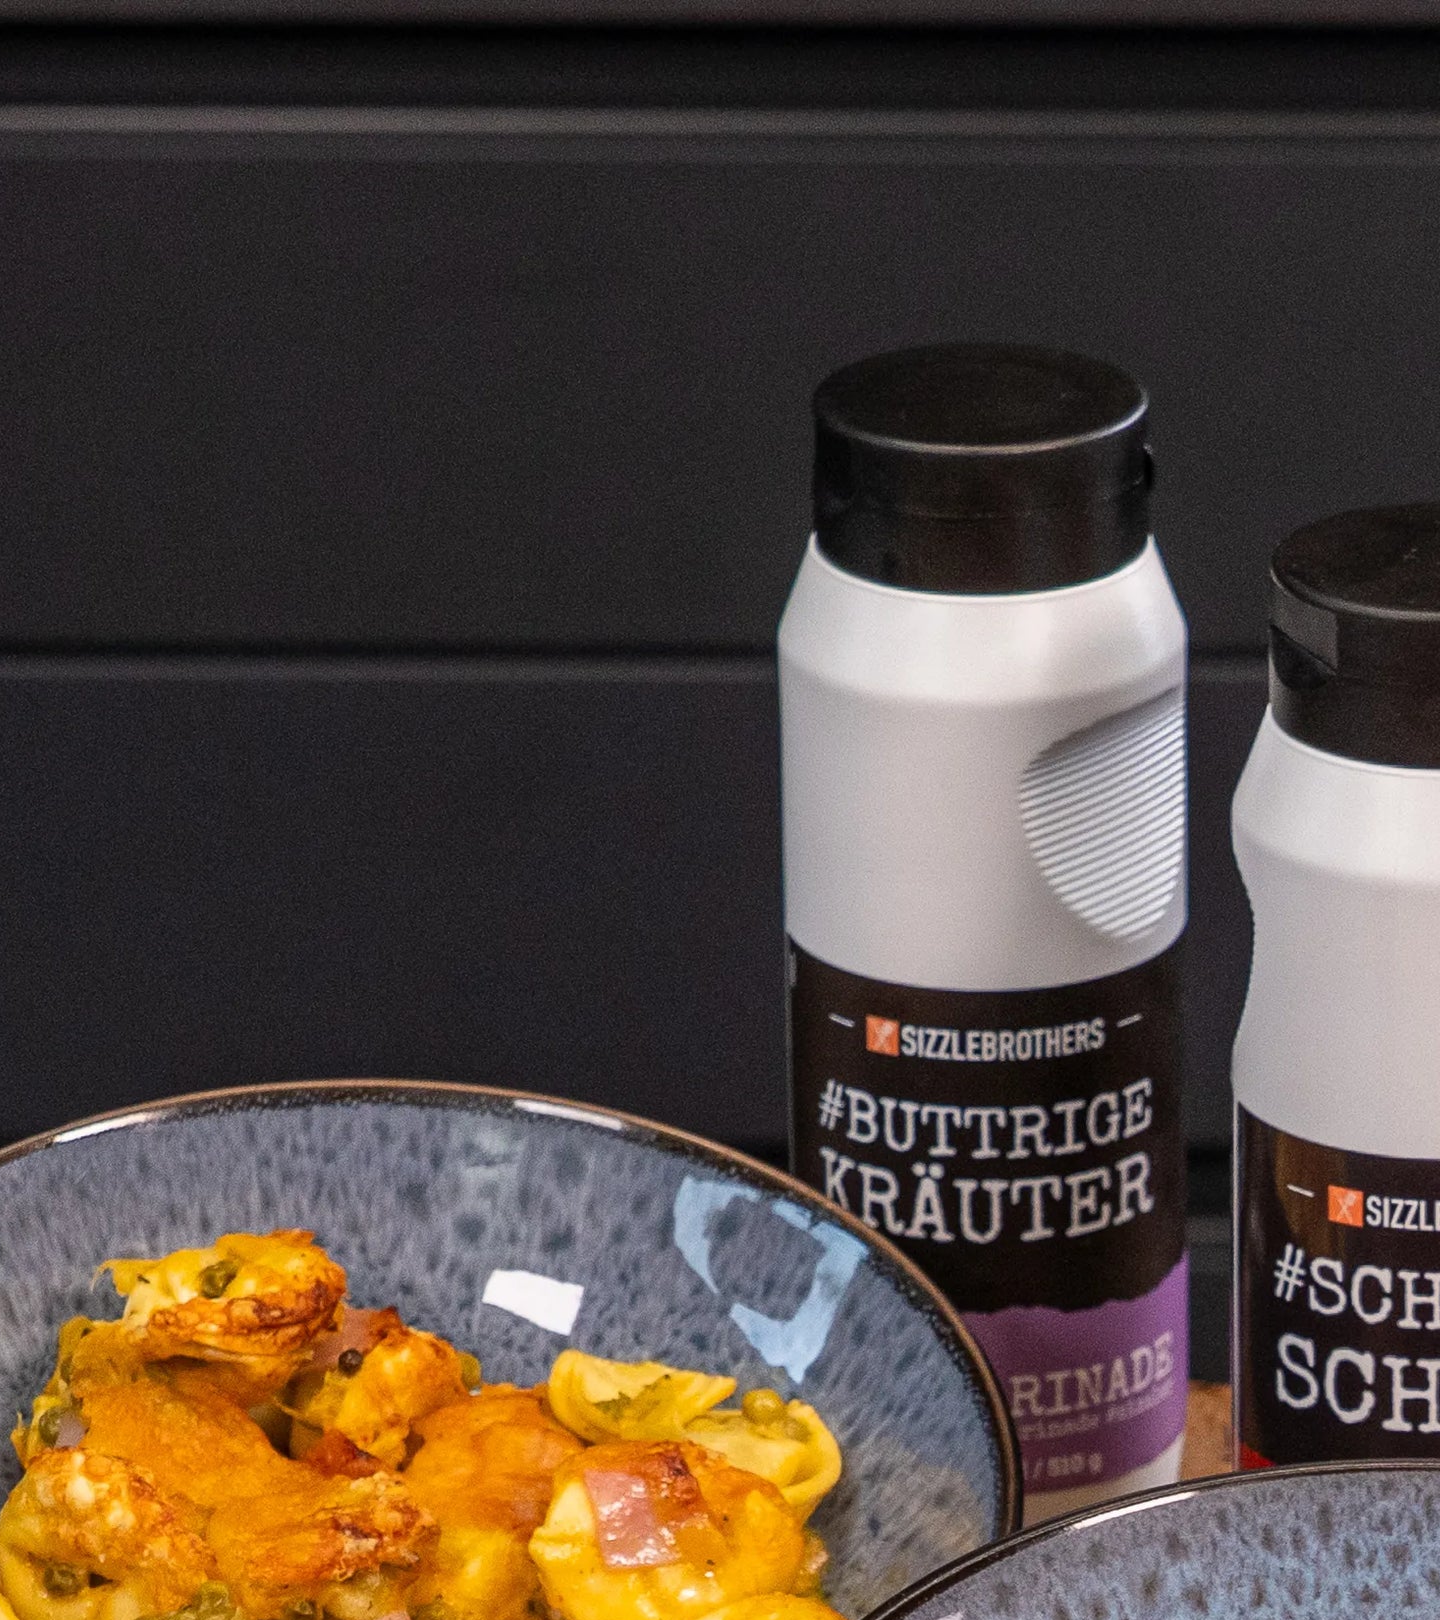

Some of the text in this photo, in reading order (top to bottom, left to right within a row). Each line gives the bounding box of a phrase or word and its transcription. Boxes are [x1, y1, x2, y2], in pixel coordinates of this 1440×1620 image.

[901, 1018, 1106, 1062] SIZZLEBROTHERS
[818, 1077, 1153, 1160] #BUTTRIGE
[820, 1147, 1155, 1244] KRÄUTER
[1010, 1331, 1174, 1418] RINADE
